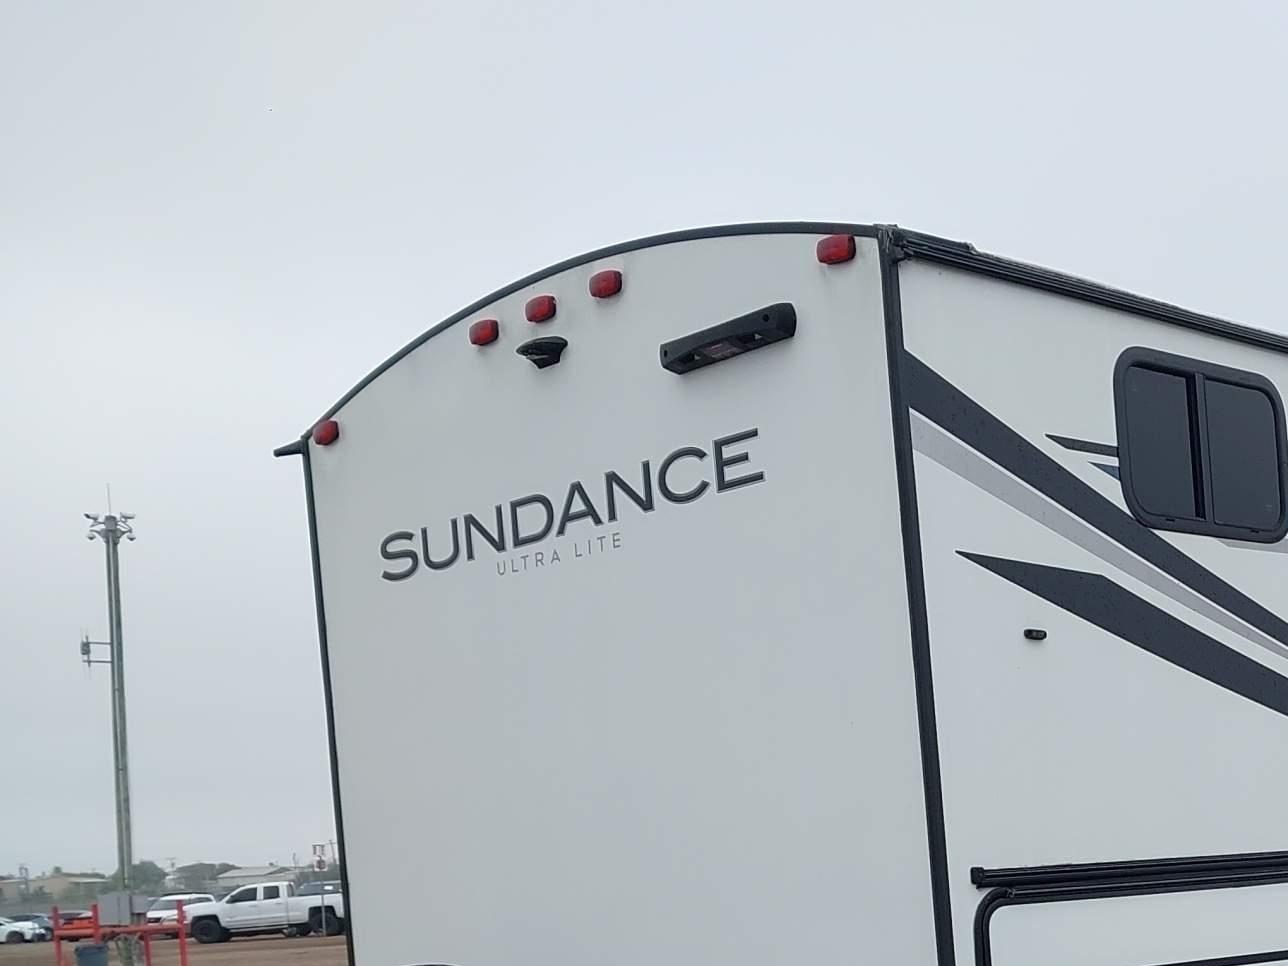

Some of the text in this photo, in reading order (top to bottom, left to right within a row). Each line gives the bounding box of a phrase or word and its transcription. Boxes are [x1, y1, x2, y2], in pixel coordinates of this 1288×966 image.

[380, 427, 766, 581] SUNDANCE
[497, 532, 623, 576] ULTRA LITE
